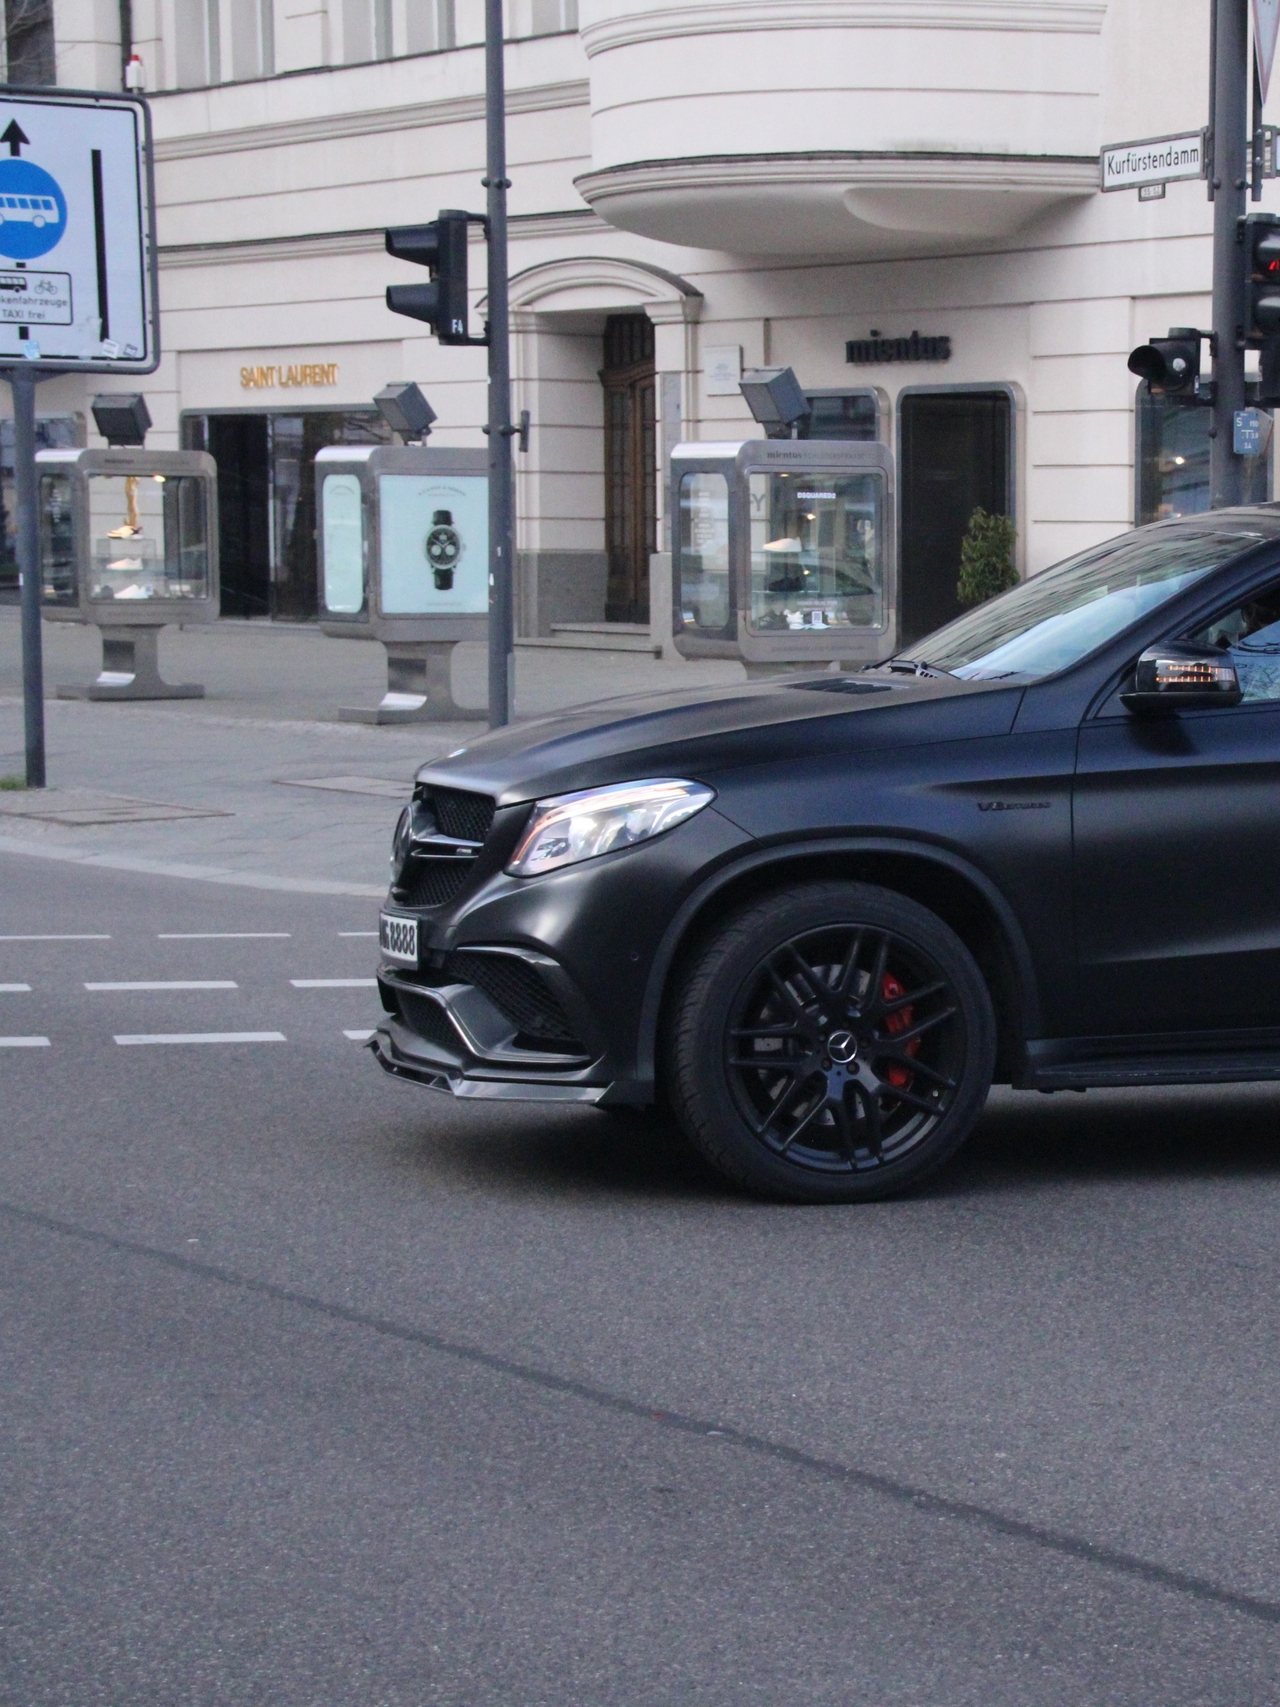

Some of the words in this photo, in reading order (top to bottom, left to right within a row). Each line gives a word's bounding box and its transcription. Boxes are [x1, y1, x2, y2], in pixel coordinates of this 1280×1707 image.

[1107, 146, 1199, 176] Kurfürstendamm
[2, 309, 24, 318] TAXI
[28, 311, 45, 319] frei
[846, 329, 952, 363] mientus
[241, 366, 276, 390] SAINT
[278, 364, 338, 388] LAURENT
